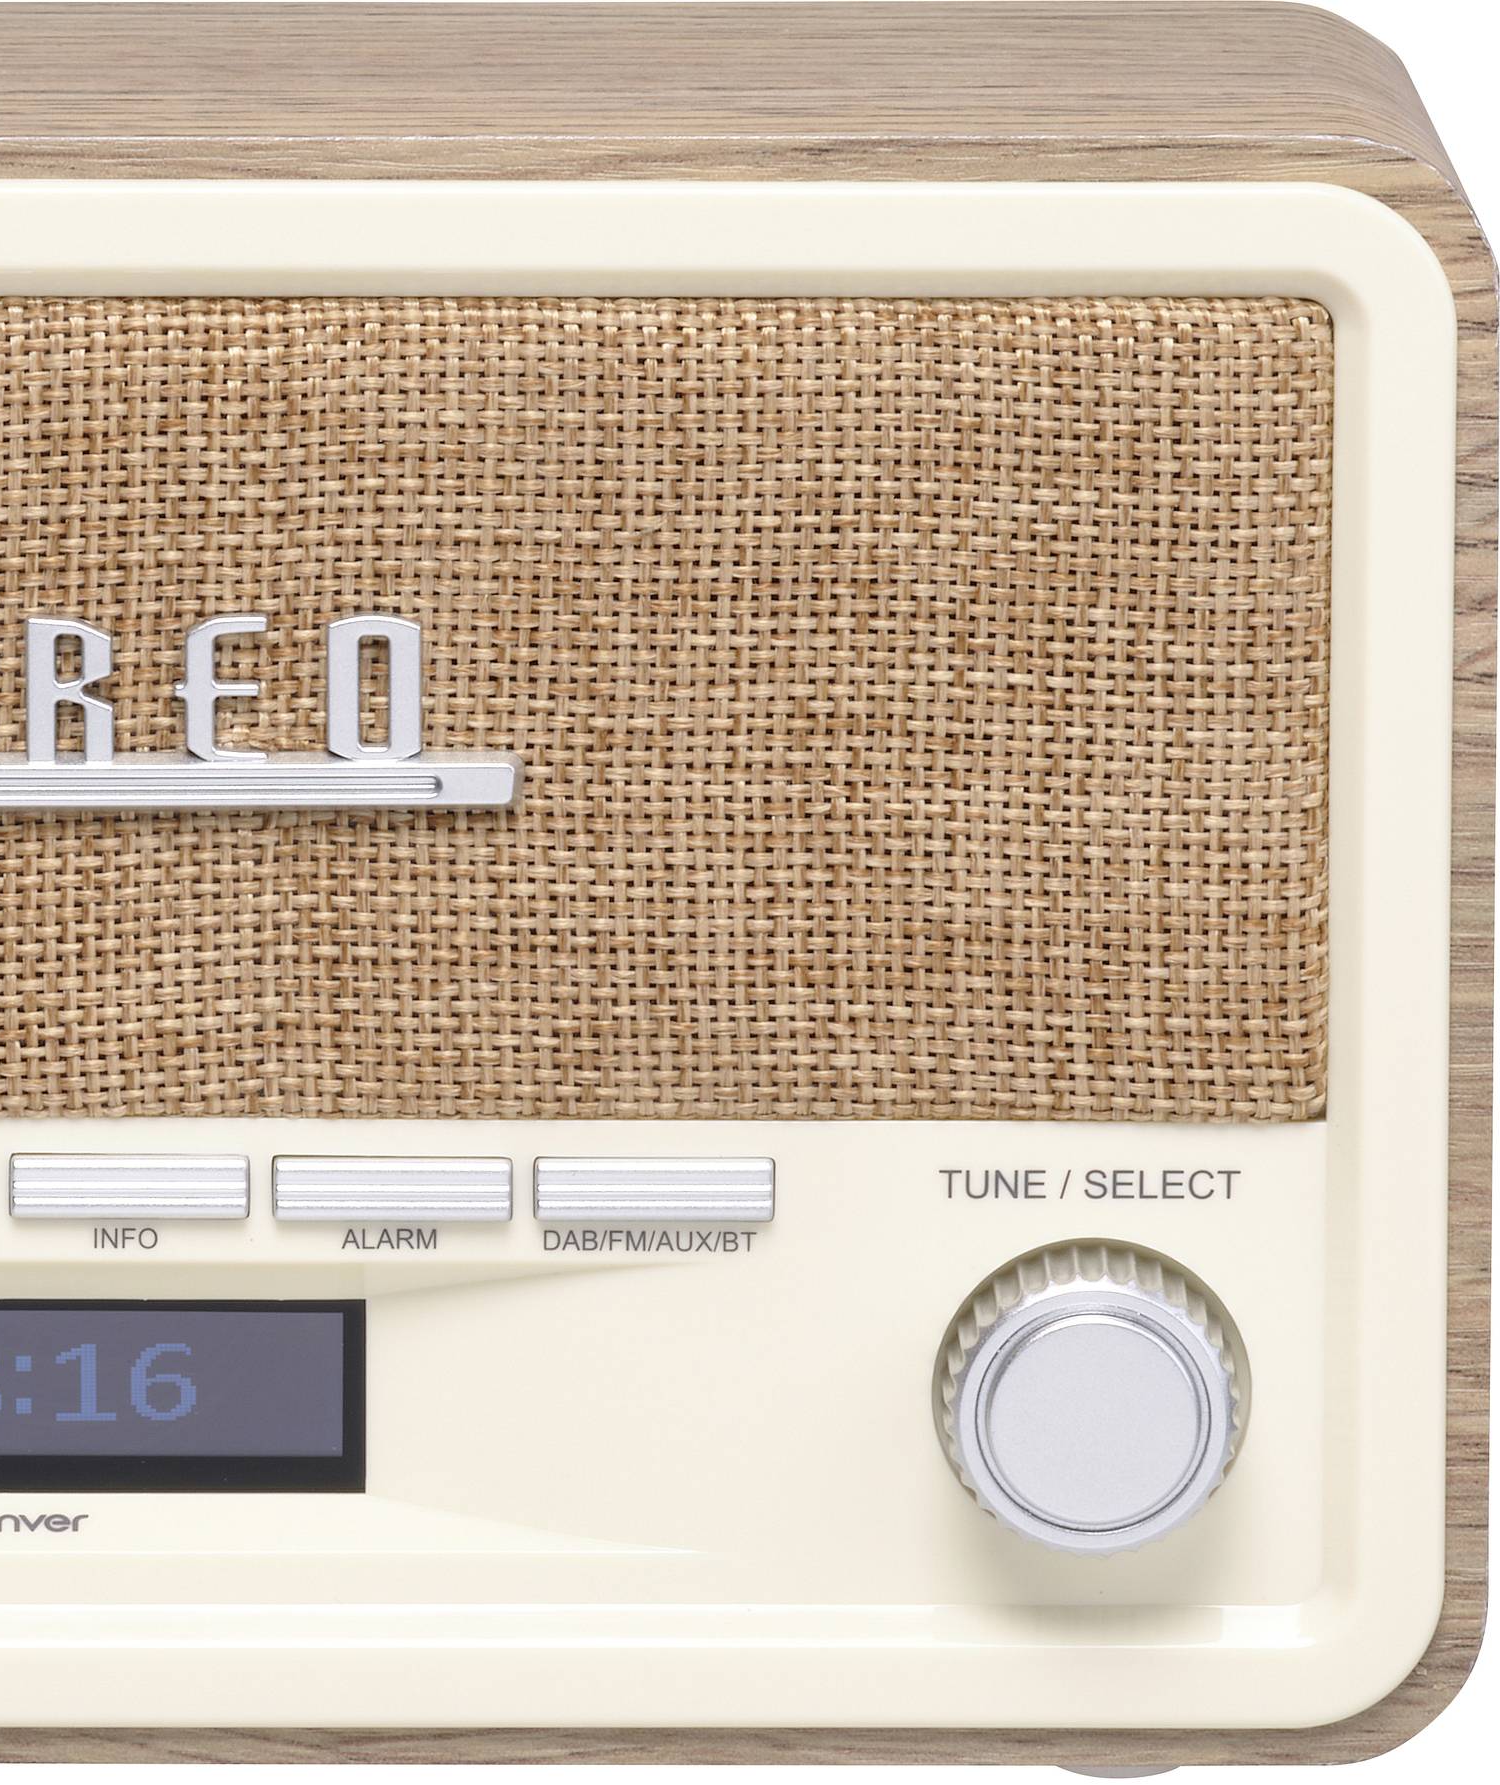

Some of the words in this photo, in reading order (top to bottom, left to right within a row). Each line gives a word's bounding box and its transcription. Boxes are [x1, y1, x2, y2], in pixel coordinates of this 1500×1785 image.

[938, 1169, 1047, 1200] TUNE
[1084, 1169, 1241, 1200] SELECT
[93, 1226, 159, 1250] INFO
[341, 1227, 438, 1250] ALARM
[542, 1229, 757, 1253] DAB/FM/AUX/BT
